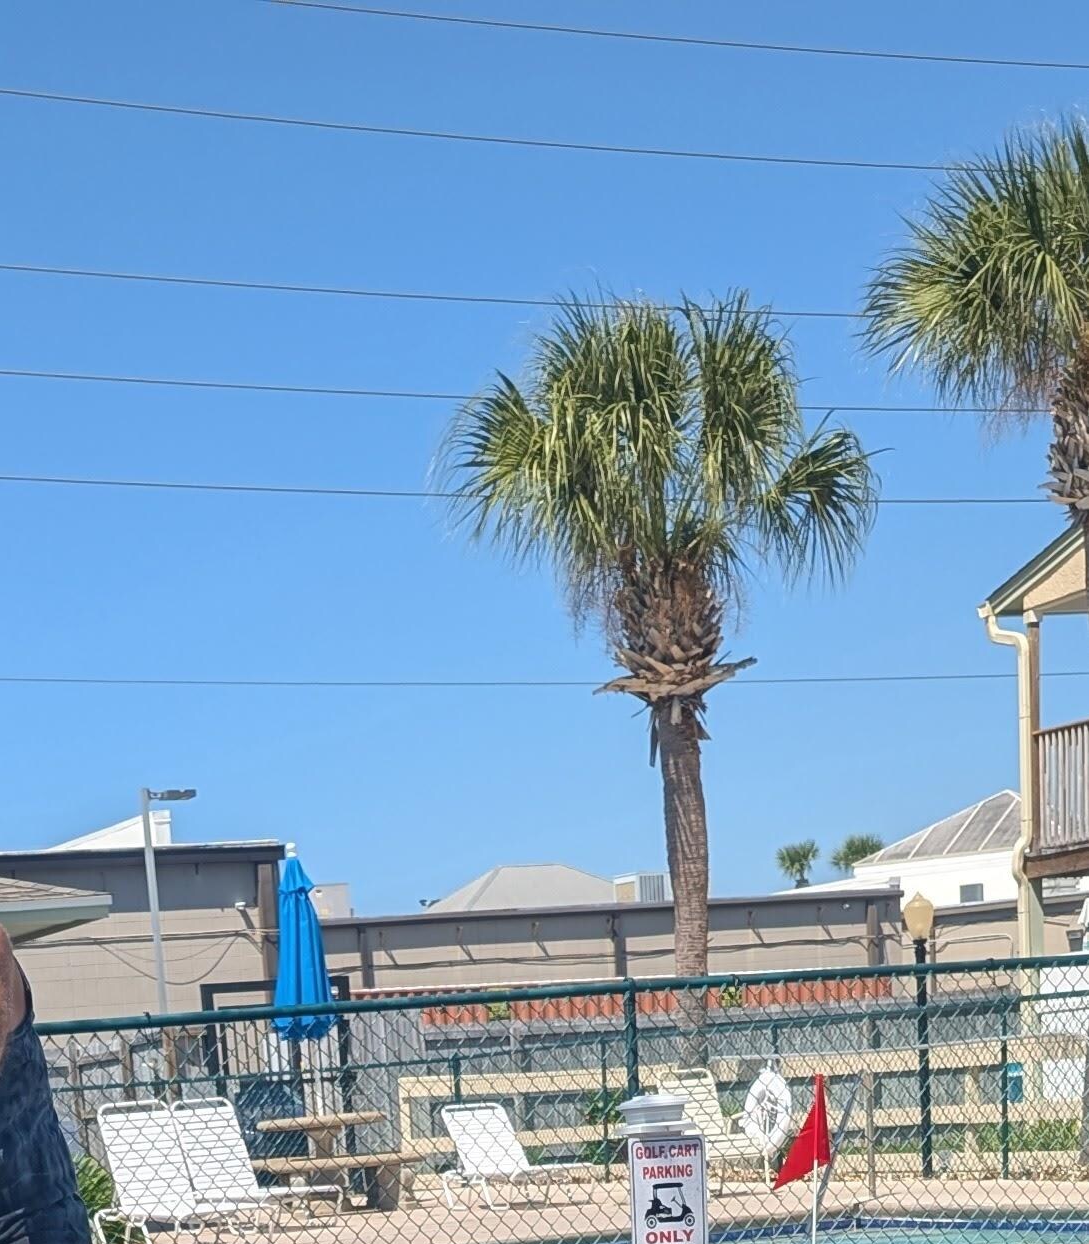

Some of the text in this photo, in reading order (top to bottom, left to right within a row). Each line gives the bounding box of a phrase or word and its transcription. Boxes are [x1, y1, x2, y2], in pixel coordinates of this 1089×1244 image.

[636, 1143, 699, 1160] GOLF CART
[642, 1164, 693, 1180] PARKING
[645, 1229, 694, 1244] ONLY
